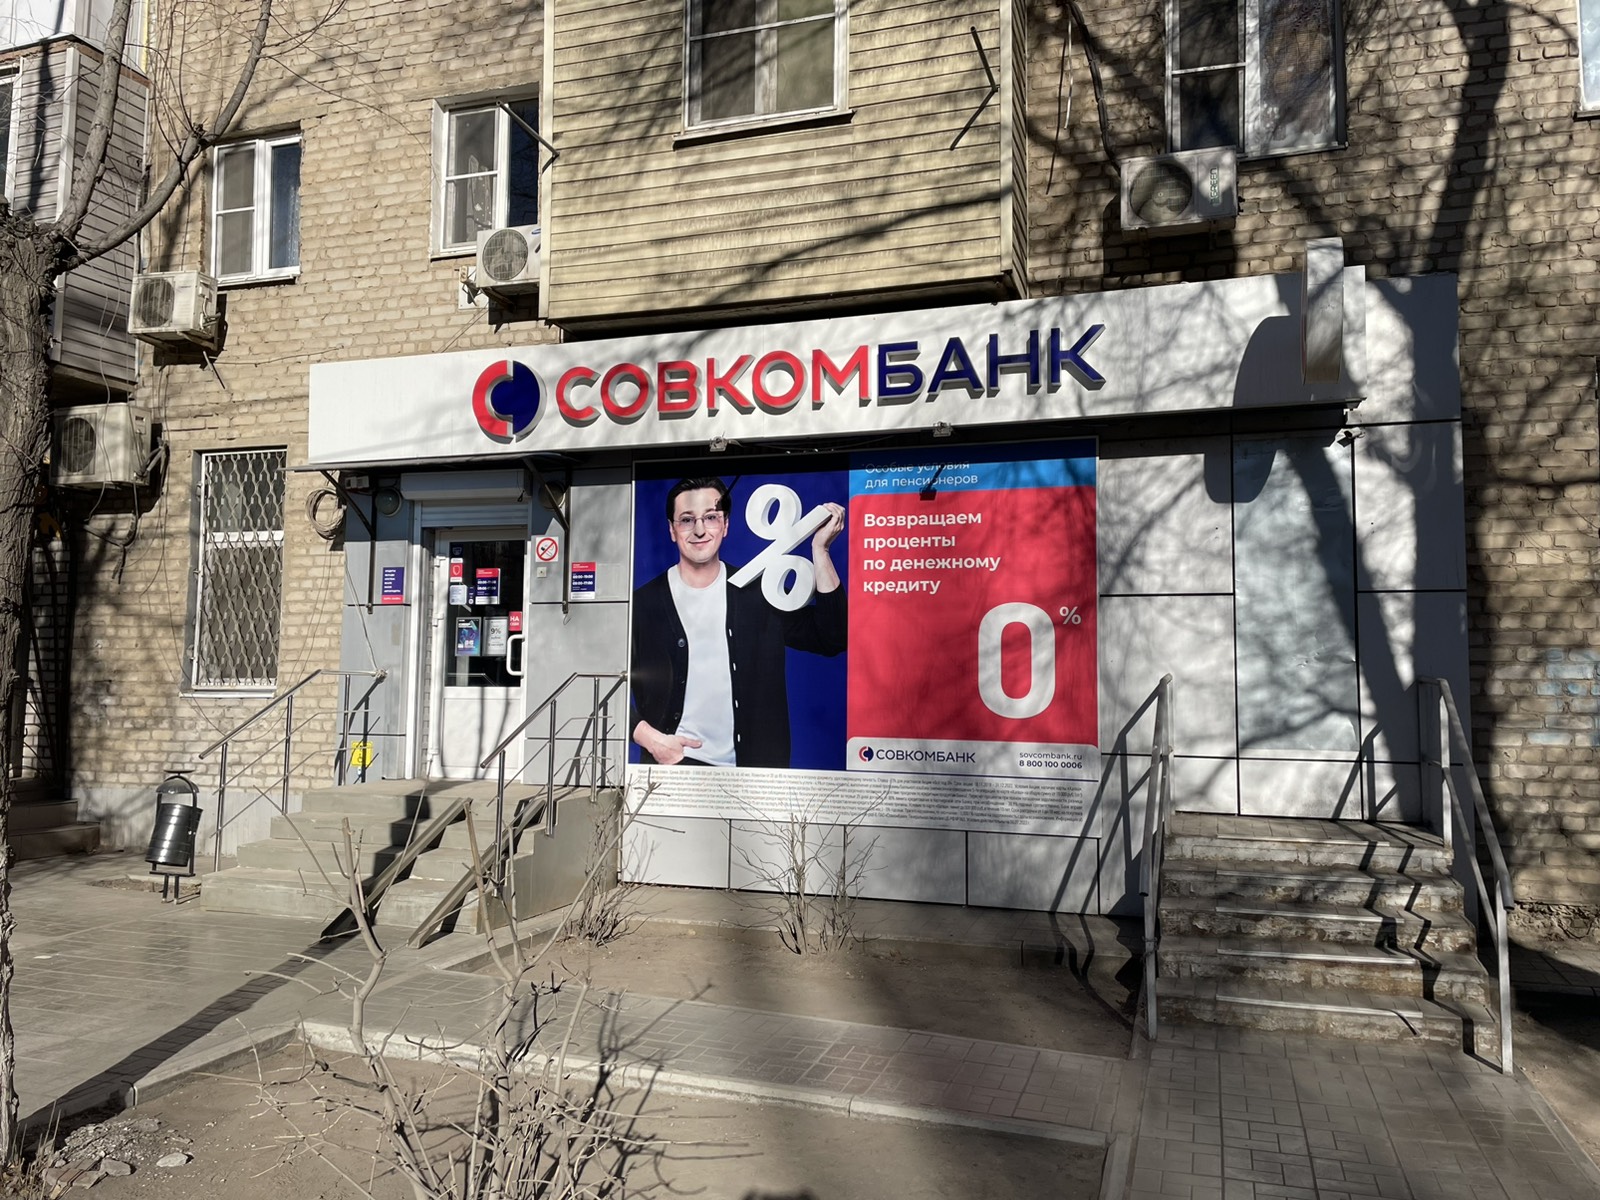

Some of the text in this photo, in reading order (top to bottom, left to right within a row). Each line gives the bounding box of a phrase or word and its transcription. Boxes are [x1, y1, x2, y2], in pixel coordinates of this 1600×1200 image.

[556, 324, 1106, 428] СОВКОМБАНК
[865, 475, 979, 489] для пенсионеров
[864, 513, 982, 529] Возвращаем
[863, 536, 956, 552] проценты
[863, 557, 1001, 571] по денежному
[863, 580, 941, 595] кредиту
[876, 749, 976, 763] СОВКОМБАНК
[1019, 752, 1083, 760] sovcombank.ru
[1060, 761, 1083, 769] 0006
